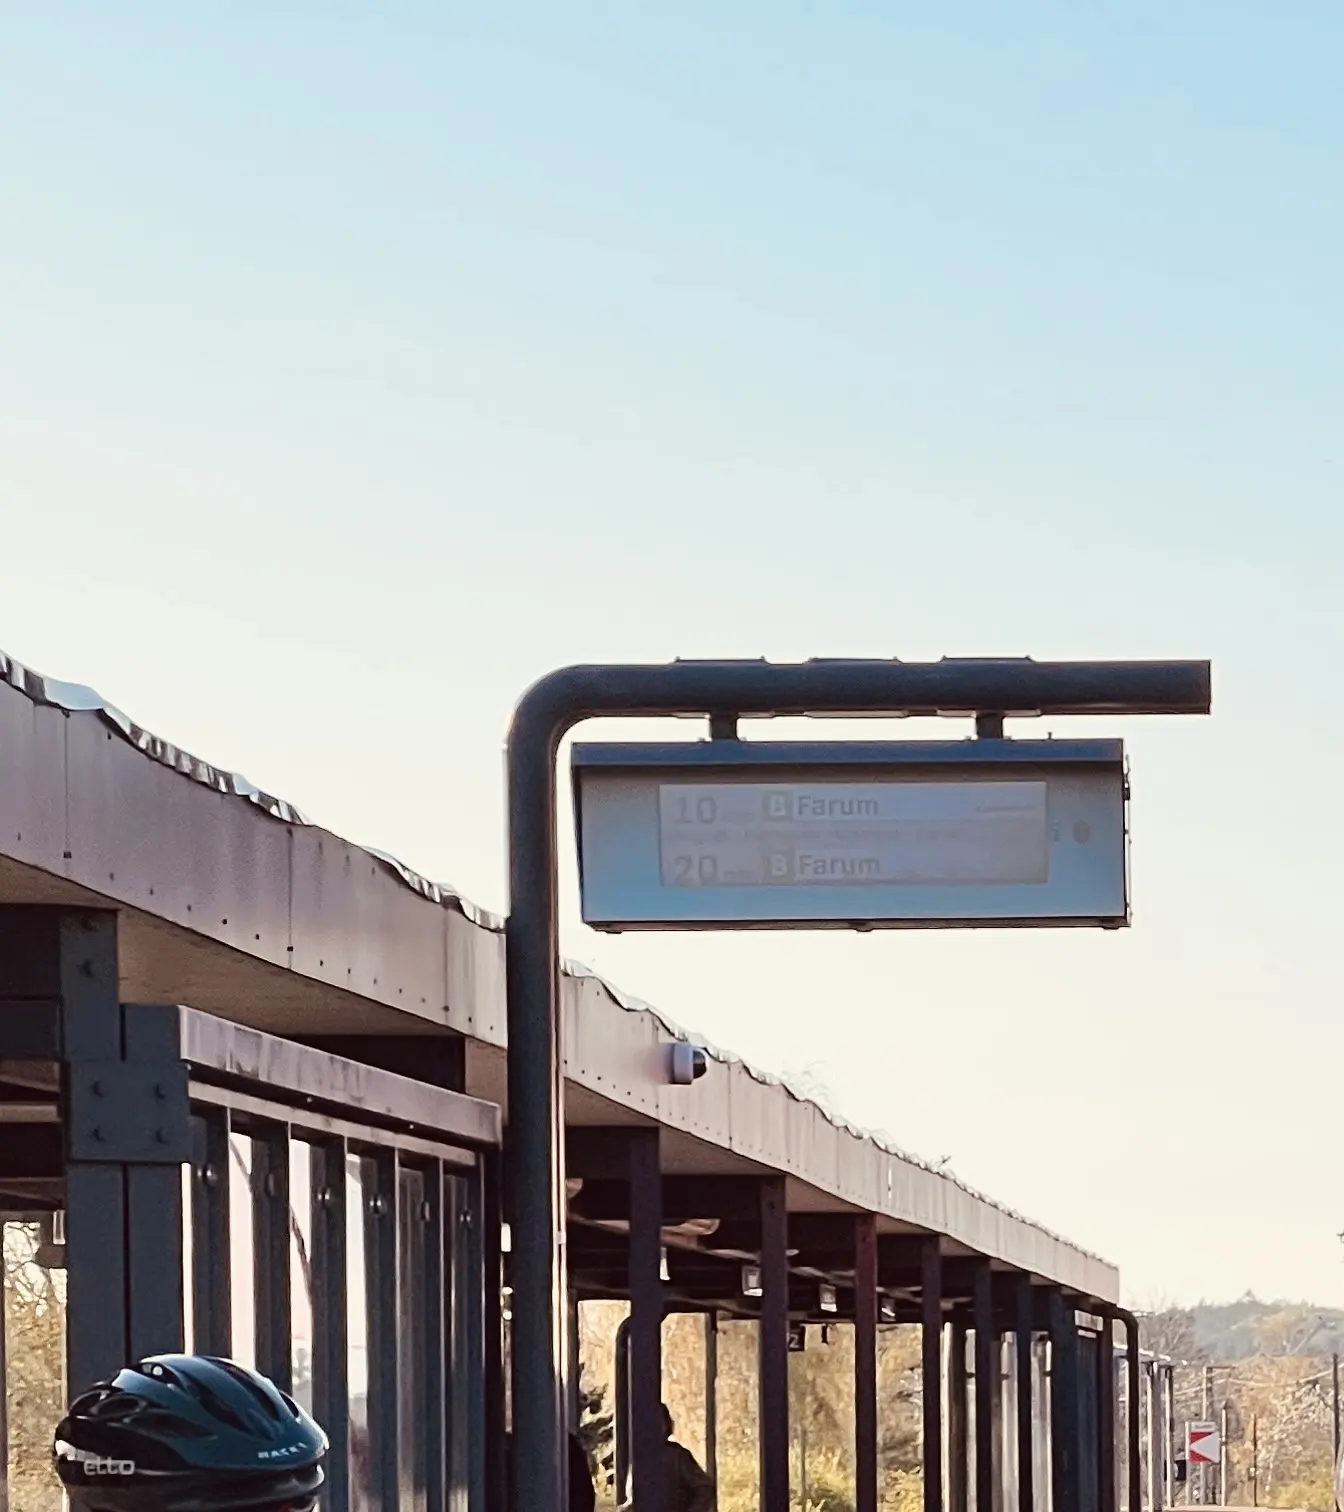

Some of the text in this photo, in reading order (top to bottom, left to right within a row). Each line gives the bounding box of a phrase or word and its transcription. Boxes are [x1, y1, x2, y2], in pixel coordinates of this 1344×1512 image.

[673, 796, 718, 824] 10
[797, 795, 880, 816] Farum
[673, 854, 881, 886] 20 B Farum
